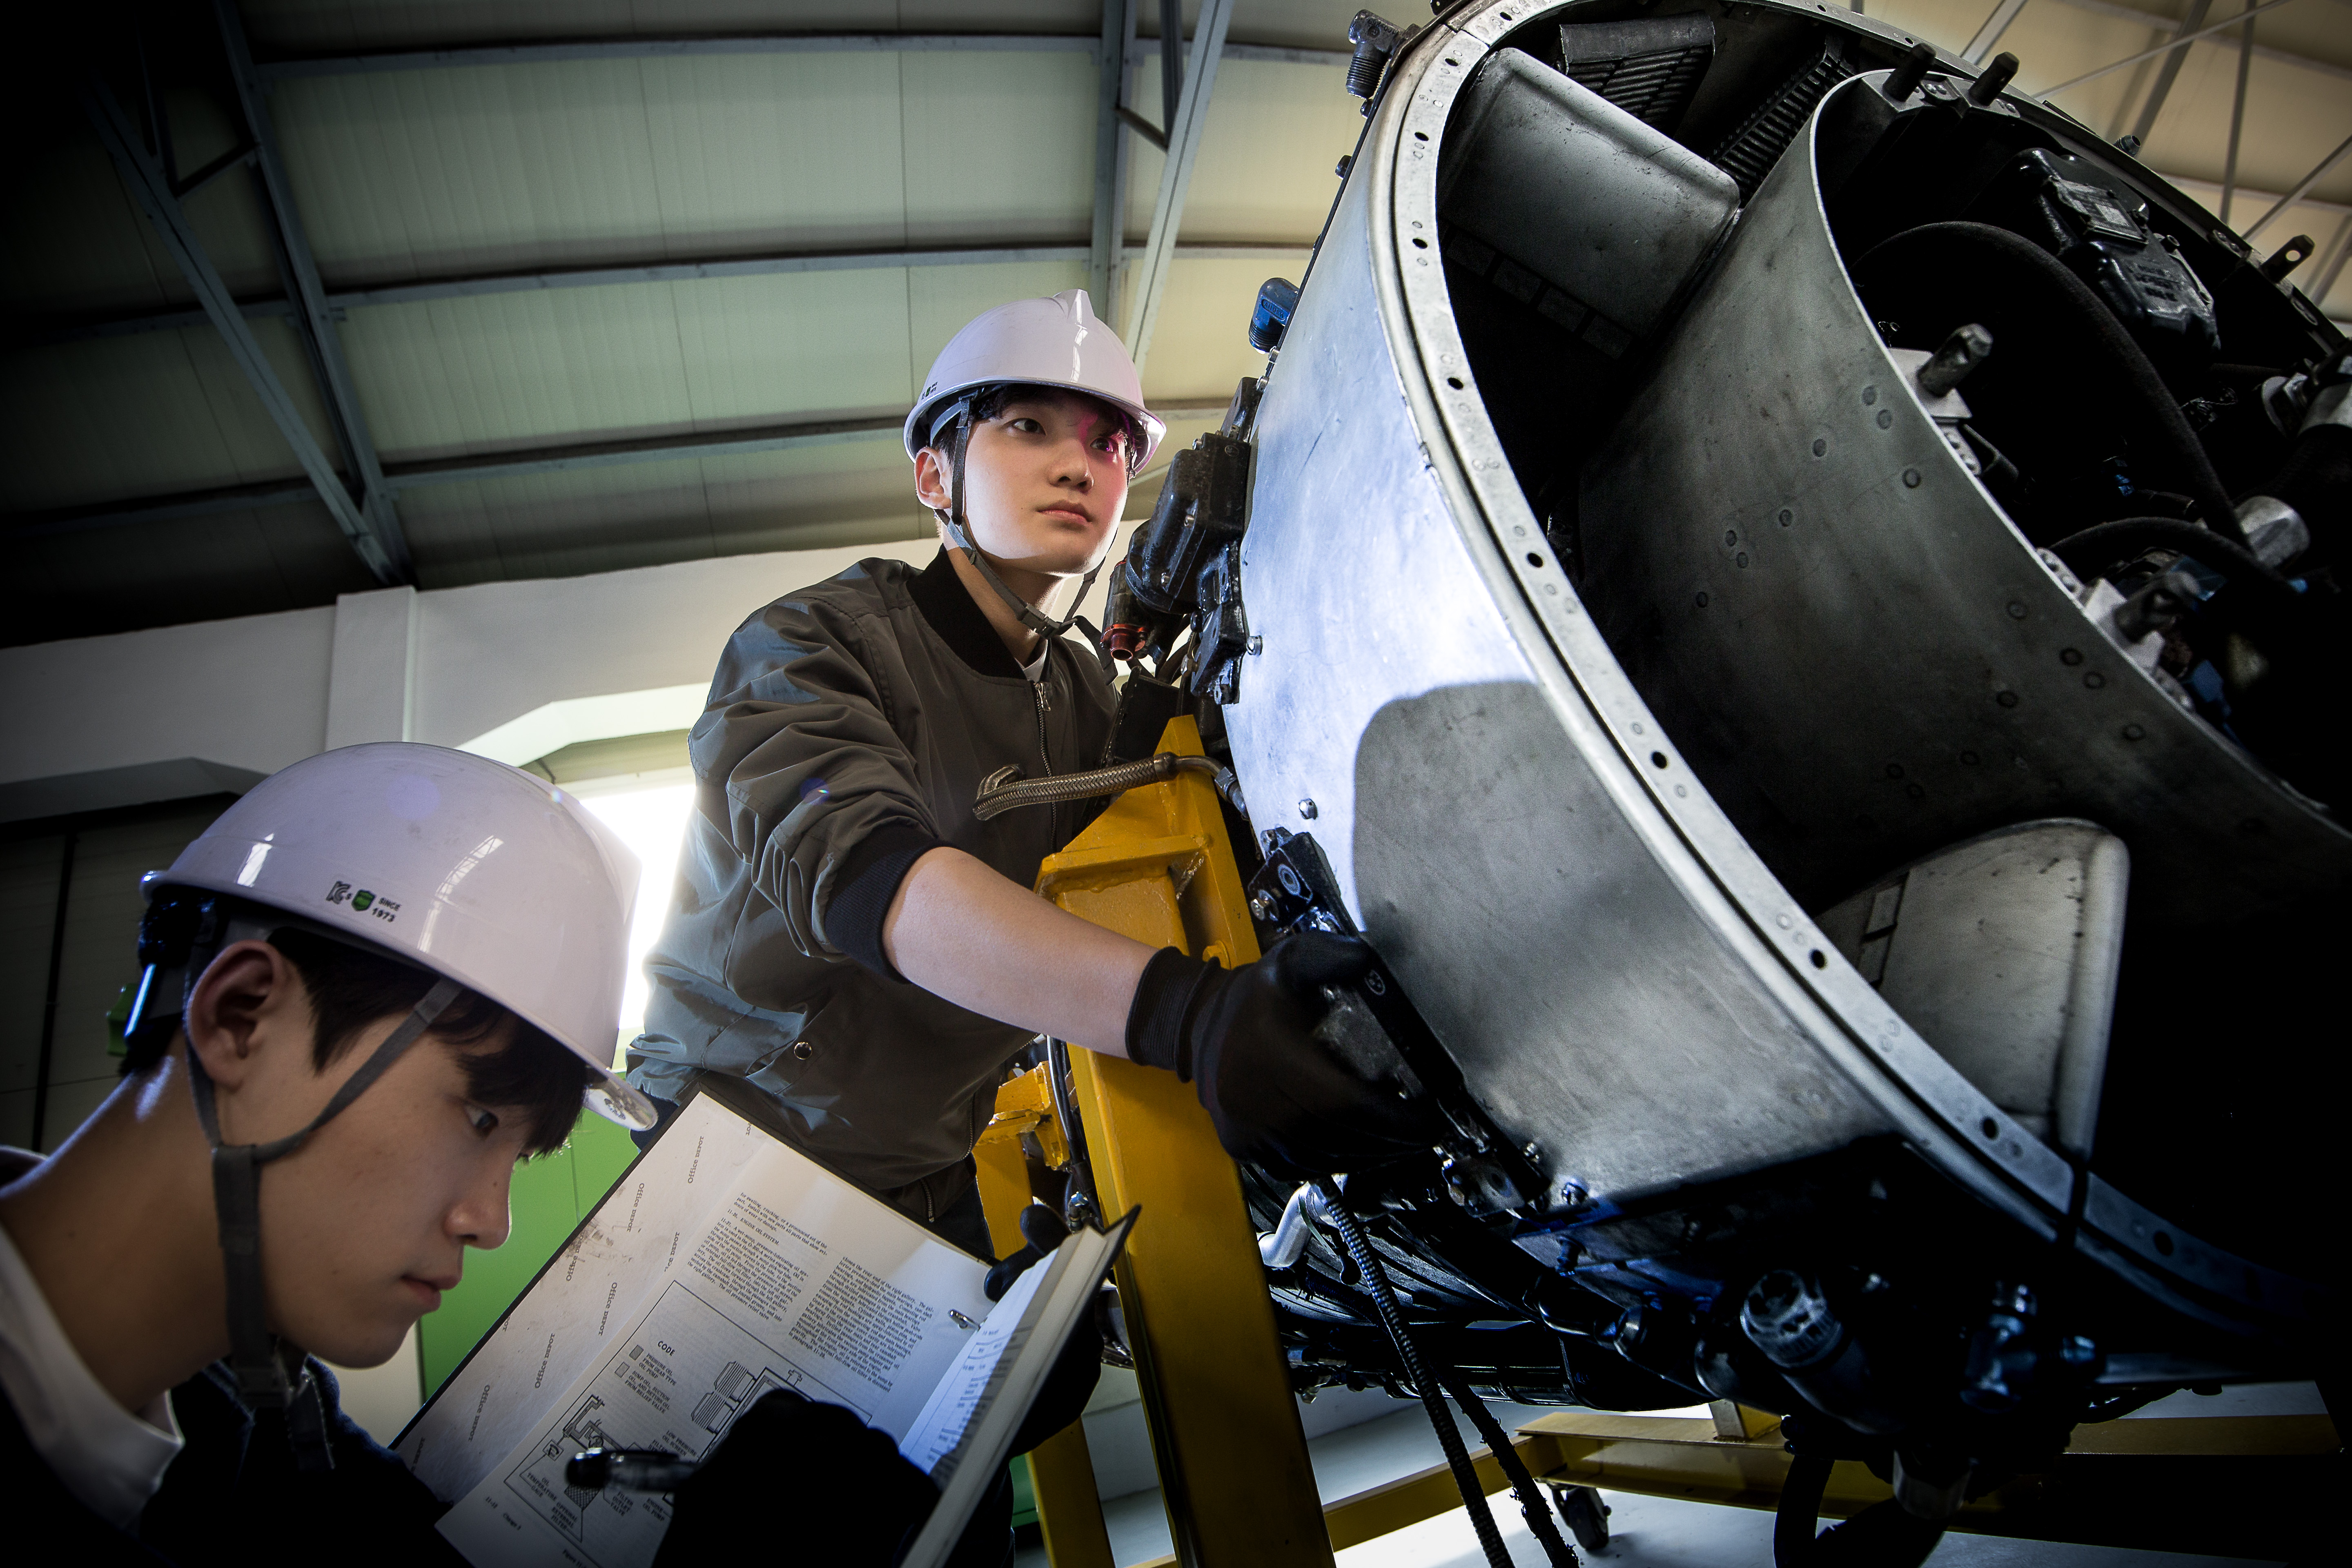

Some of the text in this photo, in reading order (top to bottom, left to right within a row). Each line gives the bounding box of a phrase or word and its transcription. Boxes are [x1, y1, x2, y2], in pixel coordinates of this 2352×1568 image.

[372, 907, 396, 923] 1973
[378, 897, 401, 912] SINCE
[688, 1136, 704, 1183] Office DEPOT
[627, 1183, 644, 1232] Office DEPOT
[734, 1201, 744, 1209] dence
[762, 1220, 777, 1232] damage.
[746, 1197, 761, 1209] swelling,
[763, 1207, 779, 1220] cracking,
[788, 1223, 810, 1238] pronounced
[748, 1203, 760, 1214] Install
[775, 1222, 786, 1230] parts
[740, 1218, 755, 1229] ENGINE
[670, 1232, 680, 1256] DEPOT
[721, 1217, 731, 1227] 11-27.
[737, 1229, 755, 1244] wet-sump,
[756, 1242, 793, 1268] pressure-lubricating
[566, 1256, 578, 1281] Office
[748, 1242, 763, 1255] O-200-A
[764, 1253, 775, 1263] series
[775, 1261, 790, 1273] engines.
[690, 1257, 703, 1267] nected
[713, 1273, 729, 1286] camshaft
[728, 1283, 739, 1292] front
[737, 1290, 753, 1302] journal
[751, 1300, 765, 1312] groove,
[701, 1272, 715, 1284] gallery.
[731, 1292, 748, 1305] pressure
[748, 1304, 760, 1313] relief
[759, 1311, 769, 1320] valve
[598, 1282, 617, 1336] Office DEPOT
[535, 1333, 555, 1388] Office DEPOT
[657, 1341, 675, 1356] CODE
[642, 1358, 677, 1386] FROM GEAR TYPE
[646, 1353, 666, 1370] PRESSURE
[646, 1368, 658, 1379] PUMP
[625, 1379, 666, 1414] FROM RELIEF VALVE
[632, 1370, 644, 1381] SUMP
[652, 1387, 670, 1402] SUCTION
[637, 1383, 647, 1391] AND
[646, 1389, 663, 1404] RETURN
[468, 1384, 490, 1442] Office DEPOT
[652, 1440, 668, 1454] FILTER
[666, 1430, 697, 1456] LOW PRESSURE
[670, 1441, 686, 1456] SCREEN
[527, 1473, 557, 1501] TEMPERATURE
[531, 1485, 543, 1497] GAGE
[617, 1491, 633, 1507] FILTER
[556, 1502, 577, 1522] OPTIONAL
[610, 1502, 625, 1516] VALVE
[612, 1496, 630, 1512] OUTLET
[646, 1498, 663, 1513] ENGINE
[651, 1510, 665, 1521] PUMP
[551, 1515, 567, 1530] FILTER
[552, 1507, 573, 1528] EXTERNAL
